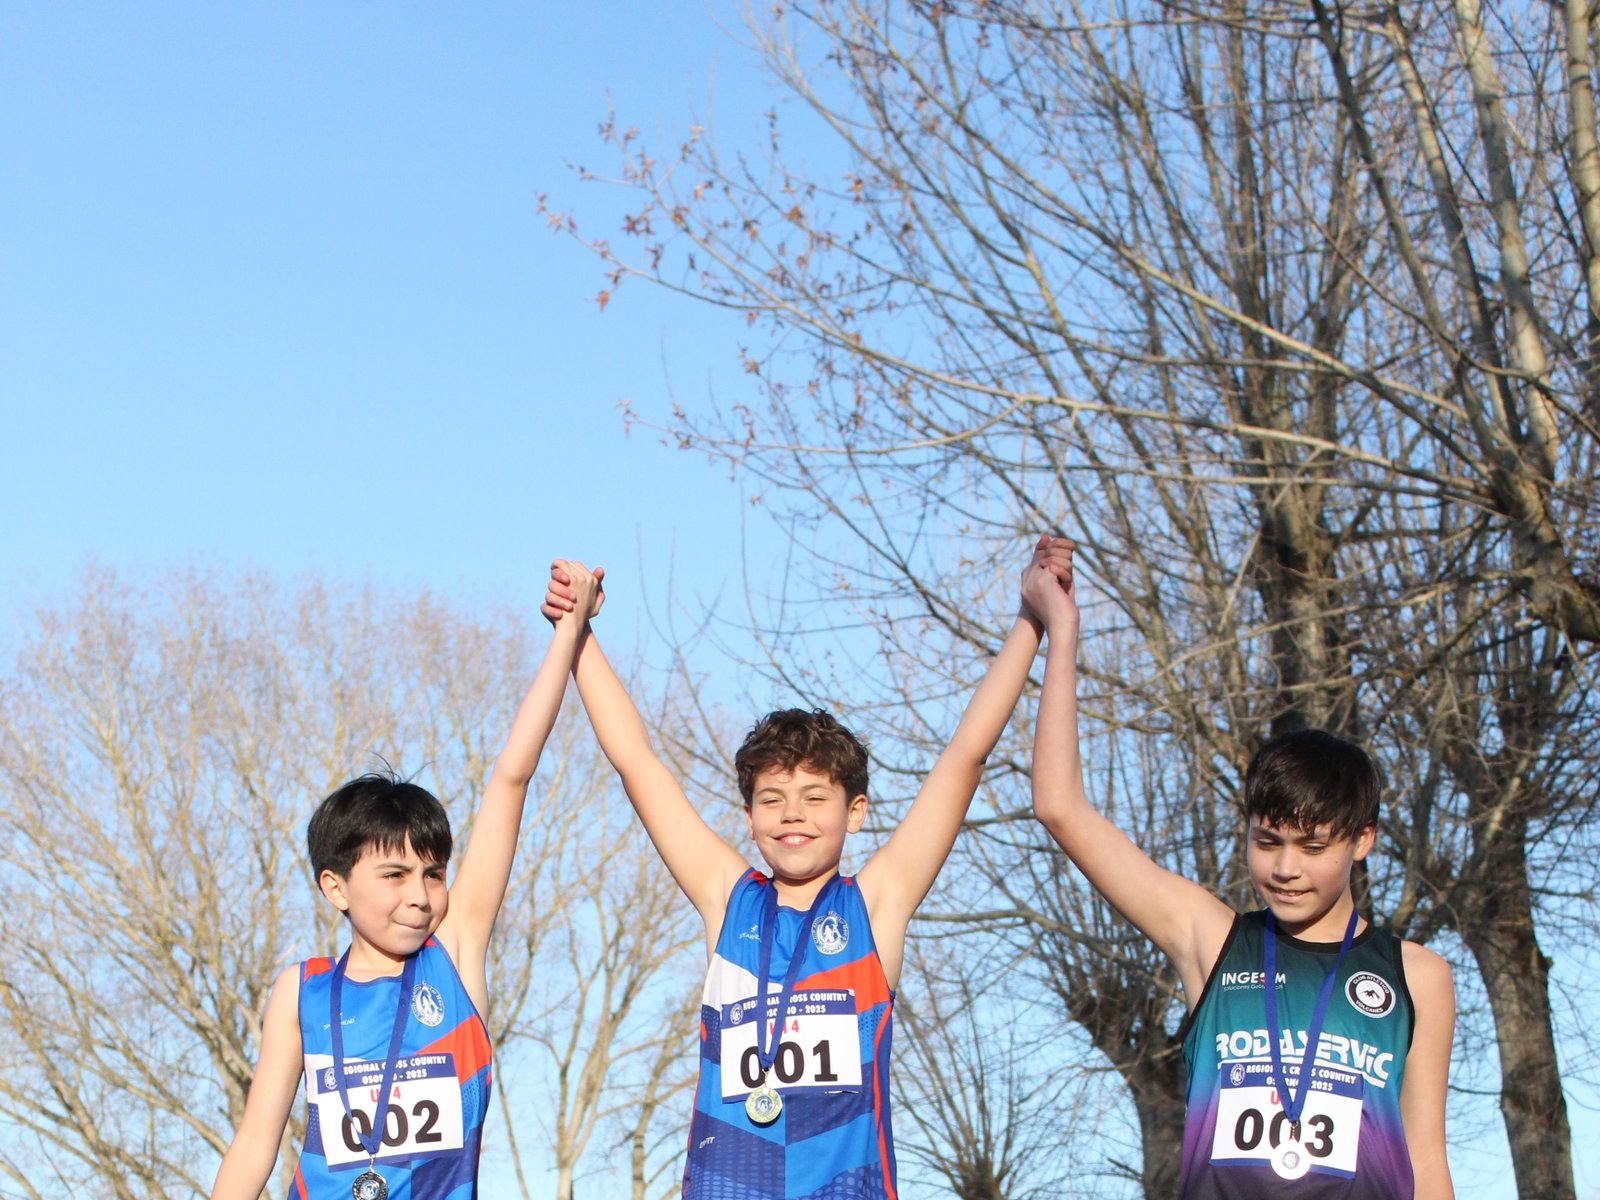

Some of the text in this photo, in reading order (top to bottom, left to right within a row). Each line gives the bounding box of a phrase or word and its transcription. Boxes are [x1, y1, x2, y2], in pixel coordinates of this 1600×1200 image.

[810, 992, 847, 1002] COUNTRY
[805, 1004, 826, 1014] 2025
[343, 1063, 380, 1075] EGIONAL
[410, 1056, 447, 1067] COUNTRY
[740, 1040, 838, 1089] 001
[405, 1069, 427, 1080] 2025
[1318, 1069, 1357, 1085] COUNTRY
[370, 1085, 401, 1103] U4
[1311, 1080, 1333, 1092] 2025
[341, 1099, 442, 1153] 002
[1234, 1107, 1335, 1158] 003
